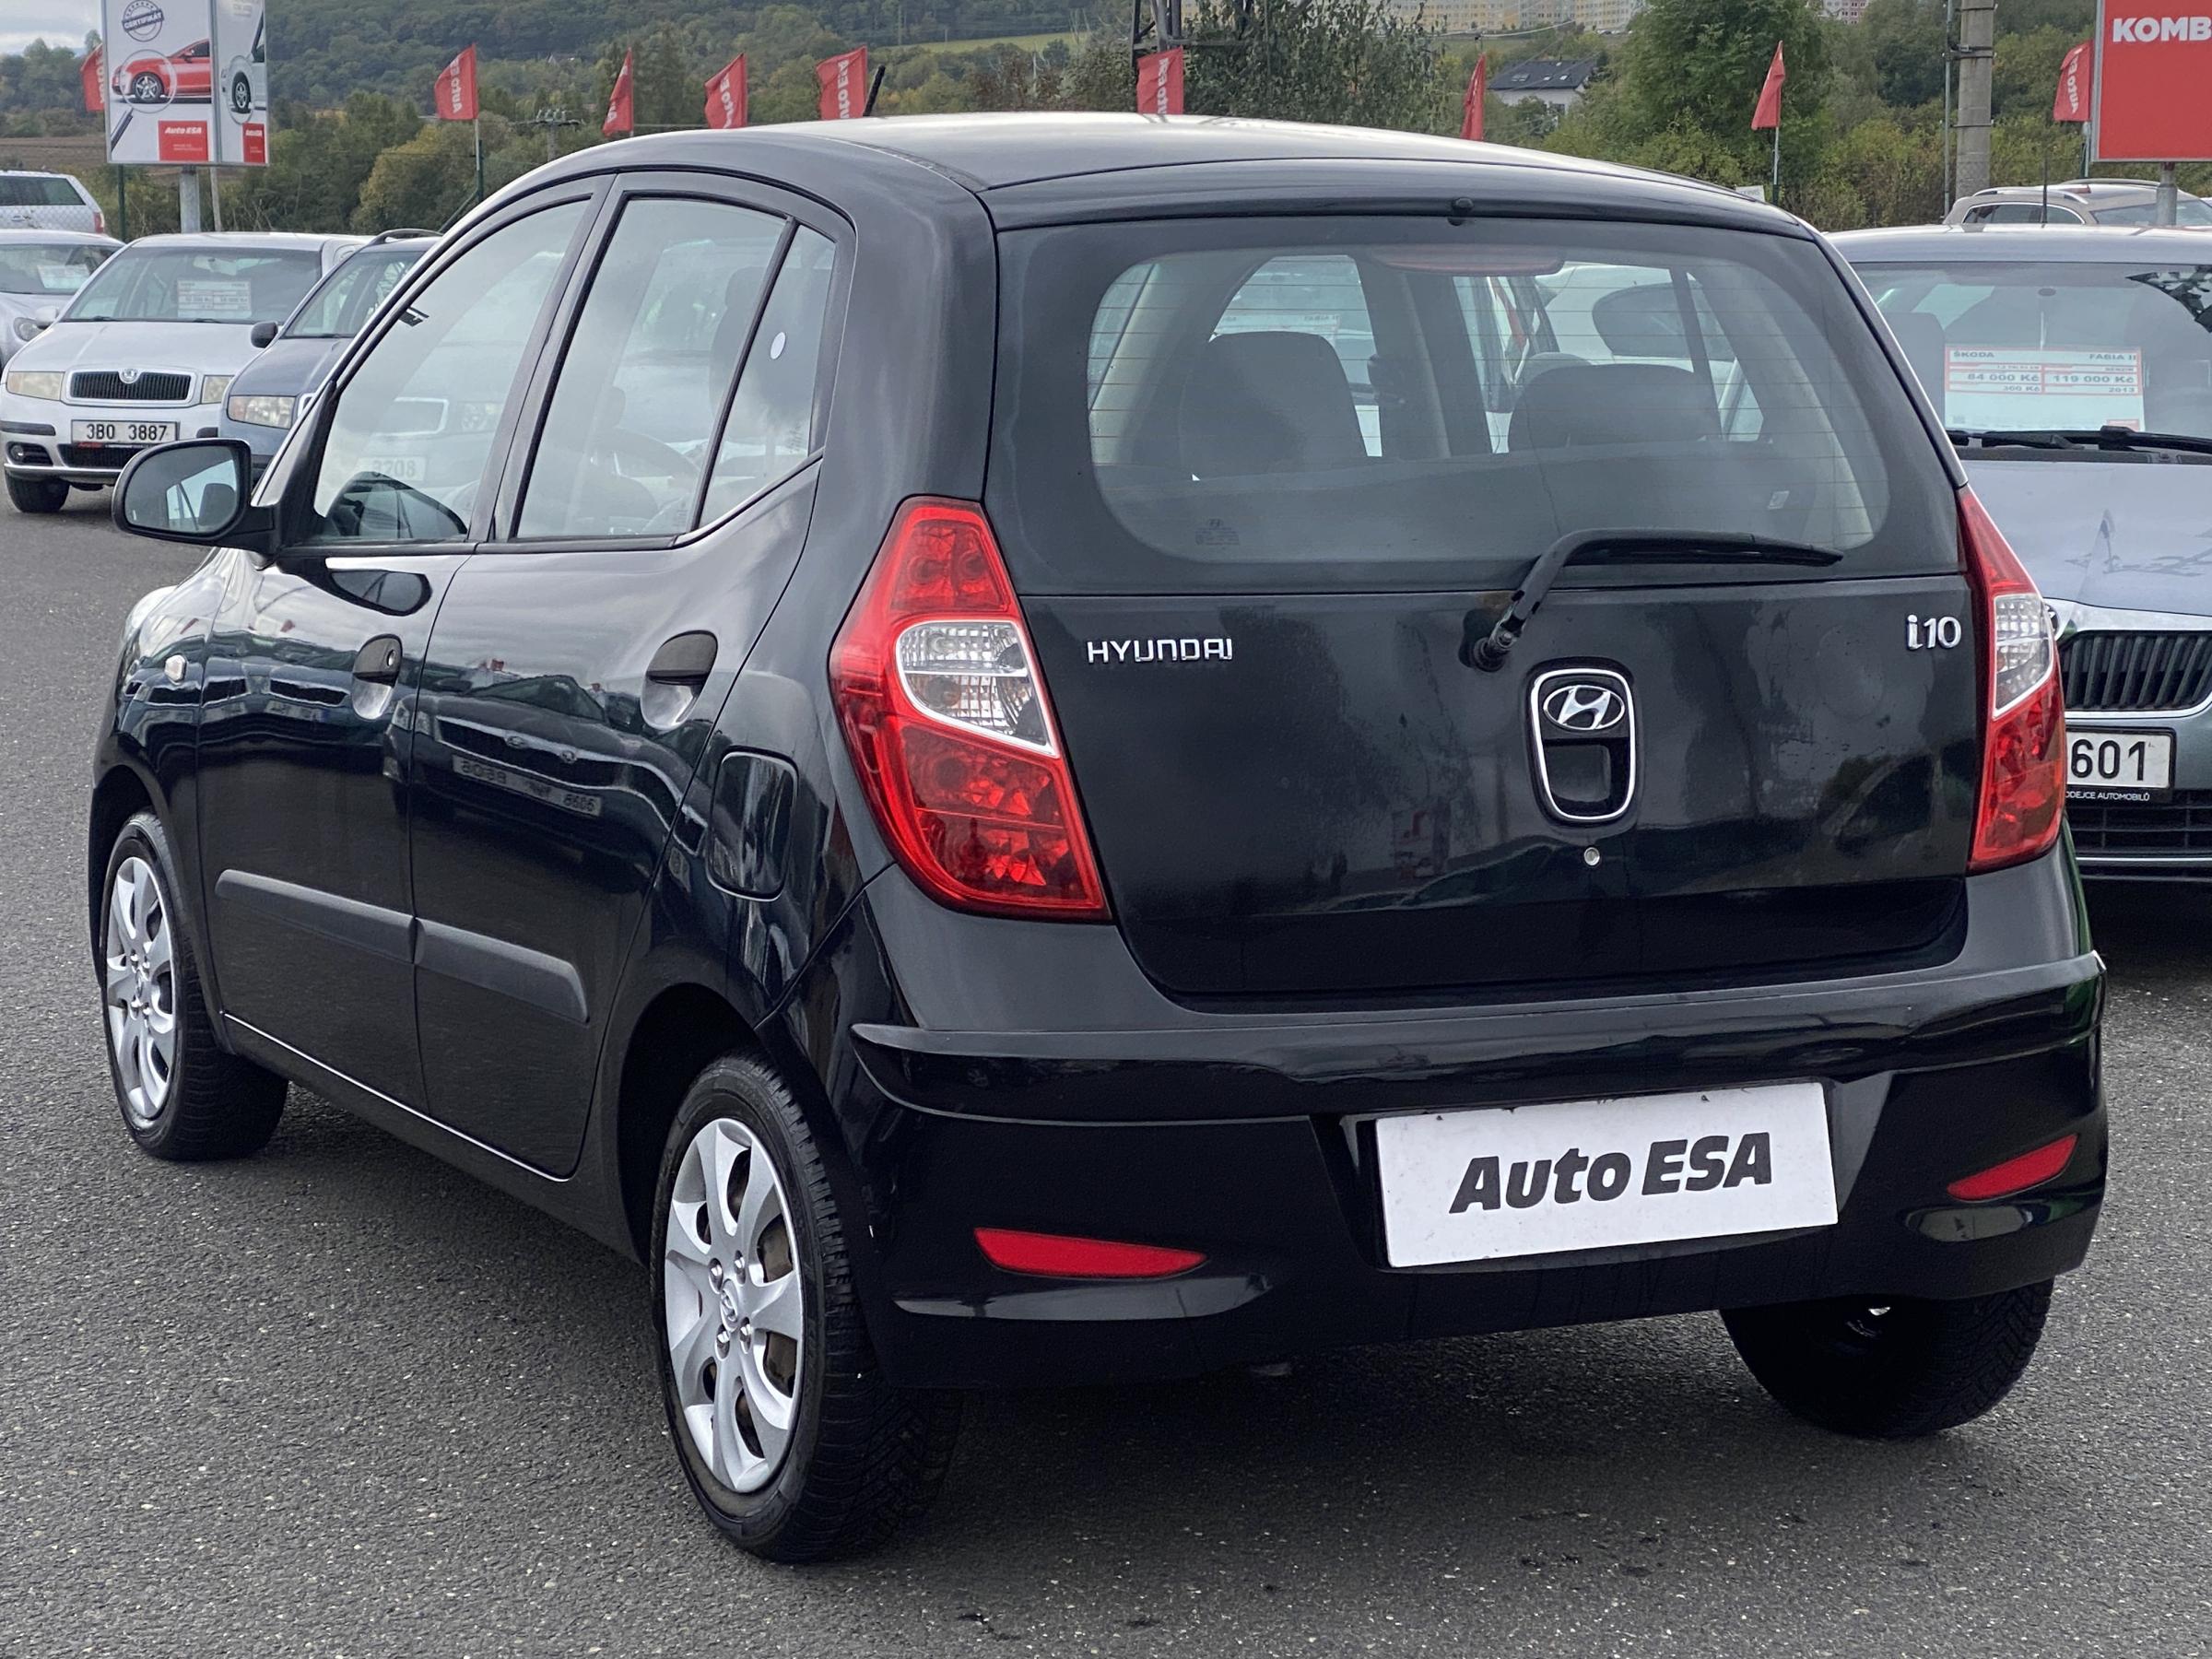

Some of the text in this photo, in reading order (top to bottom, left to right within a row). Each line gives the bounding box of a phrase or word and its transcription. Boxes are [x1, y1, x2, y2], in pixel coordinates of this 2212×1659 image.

[2112, 17, 2212, 42] KOMB
[2020, 373, 2040, 382] Kč
[128, 425, 168, 441] 3887
[1907, 614, 1962, 651] i10
[1087, 638, 1233, 664] HYUNDAI
[2070, 738, 2146, 782] 601
[2097, 792, 2150, 802] AUTOMOBILŮ
[1448, 1131, 1772, 1215] Auto ESA
